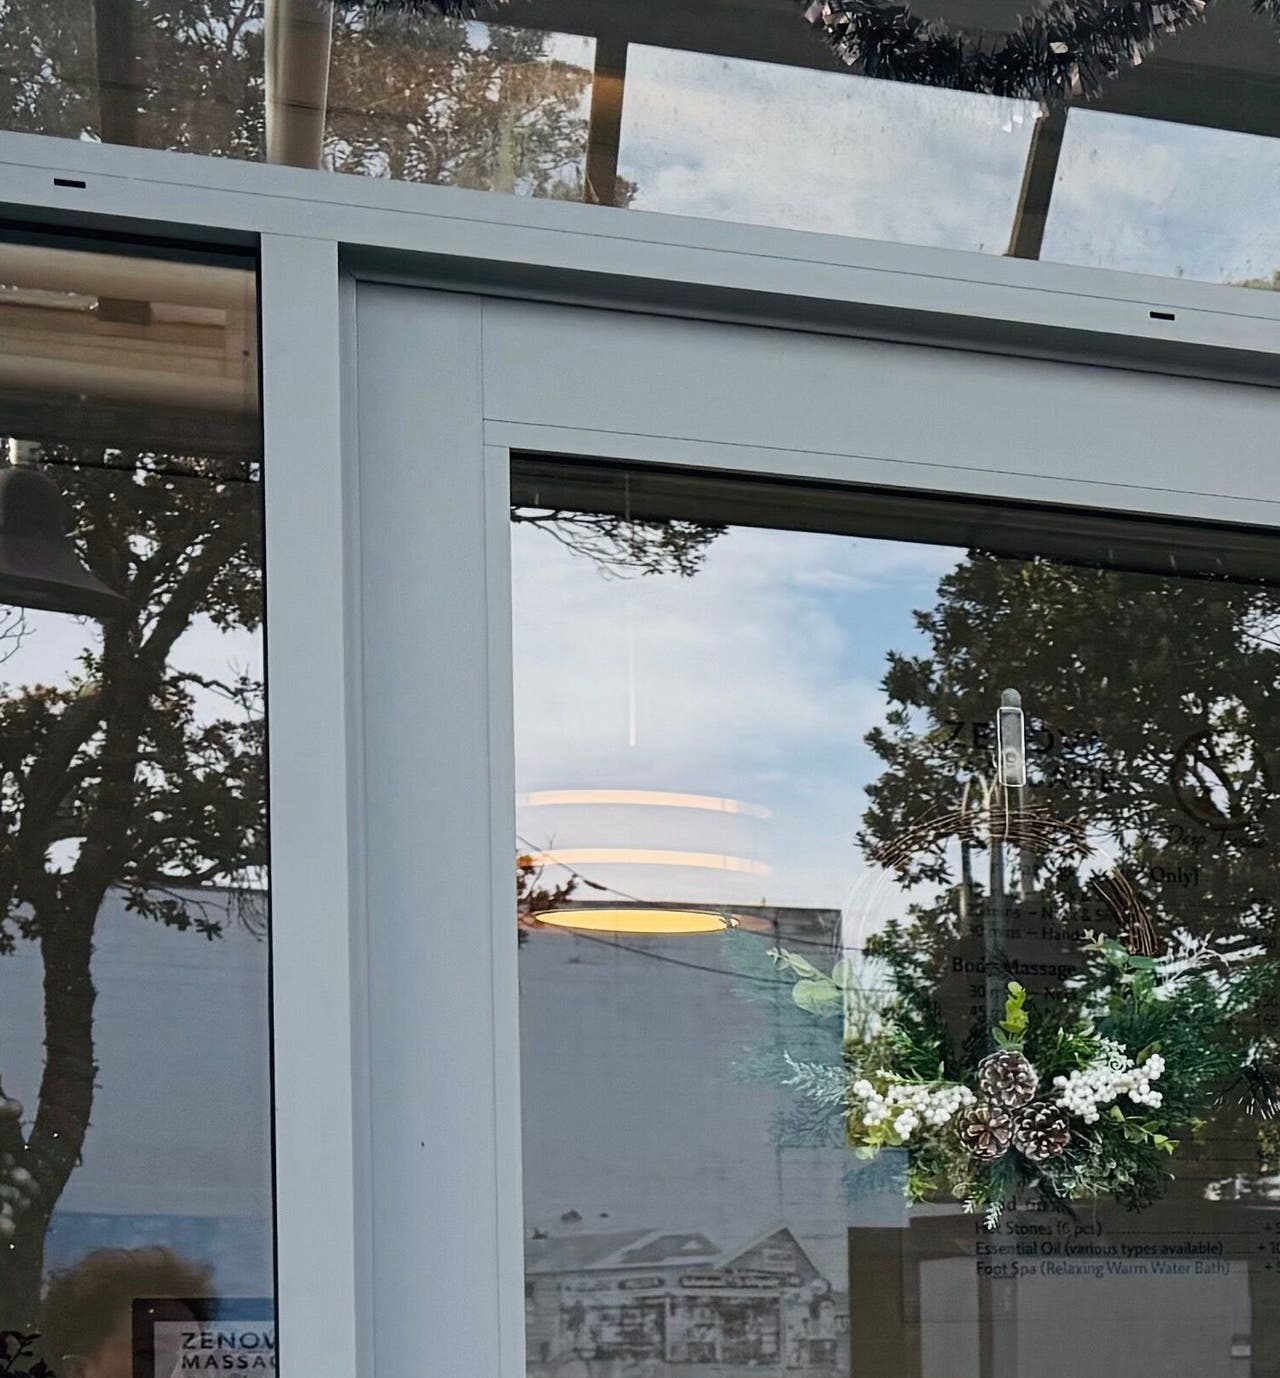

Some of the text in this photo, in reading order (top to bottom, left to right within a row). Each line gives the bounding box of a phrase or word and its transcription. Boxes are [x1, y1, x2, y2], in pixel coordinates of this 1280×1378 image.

[975, 1241, 1038, 1256] Essential
[1041, 1241, 1061, 1255] Oil
[1065, 1241, 1118, 1258] (various
[1121, 1243, 1157, 1259] types
[1160, 1241, 1224, 1258] available)
[976, 1261, 1010, 1276] Foot
[1011, 1261, 1037, 1279] Spa
[1040, 1261, 1104, 1280] (Relaxing
[1107, 1262, 1147, 1276] Warm
[1151, 1261, 1191, 1276] Water
